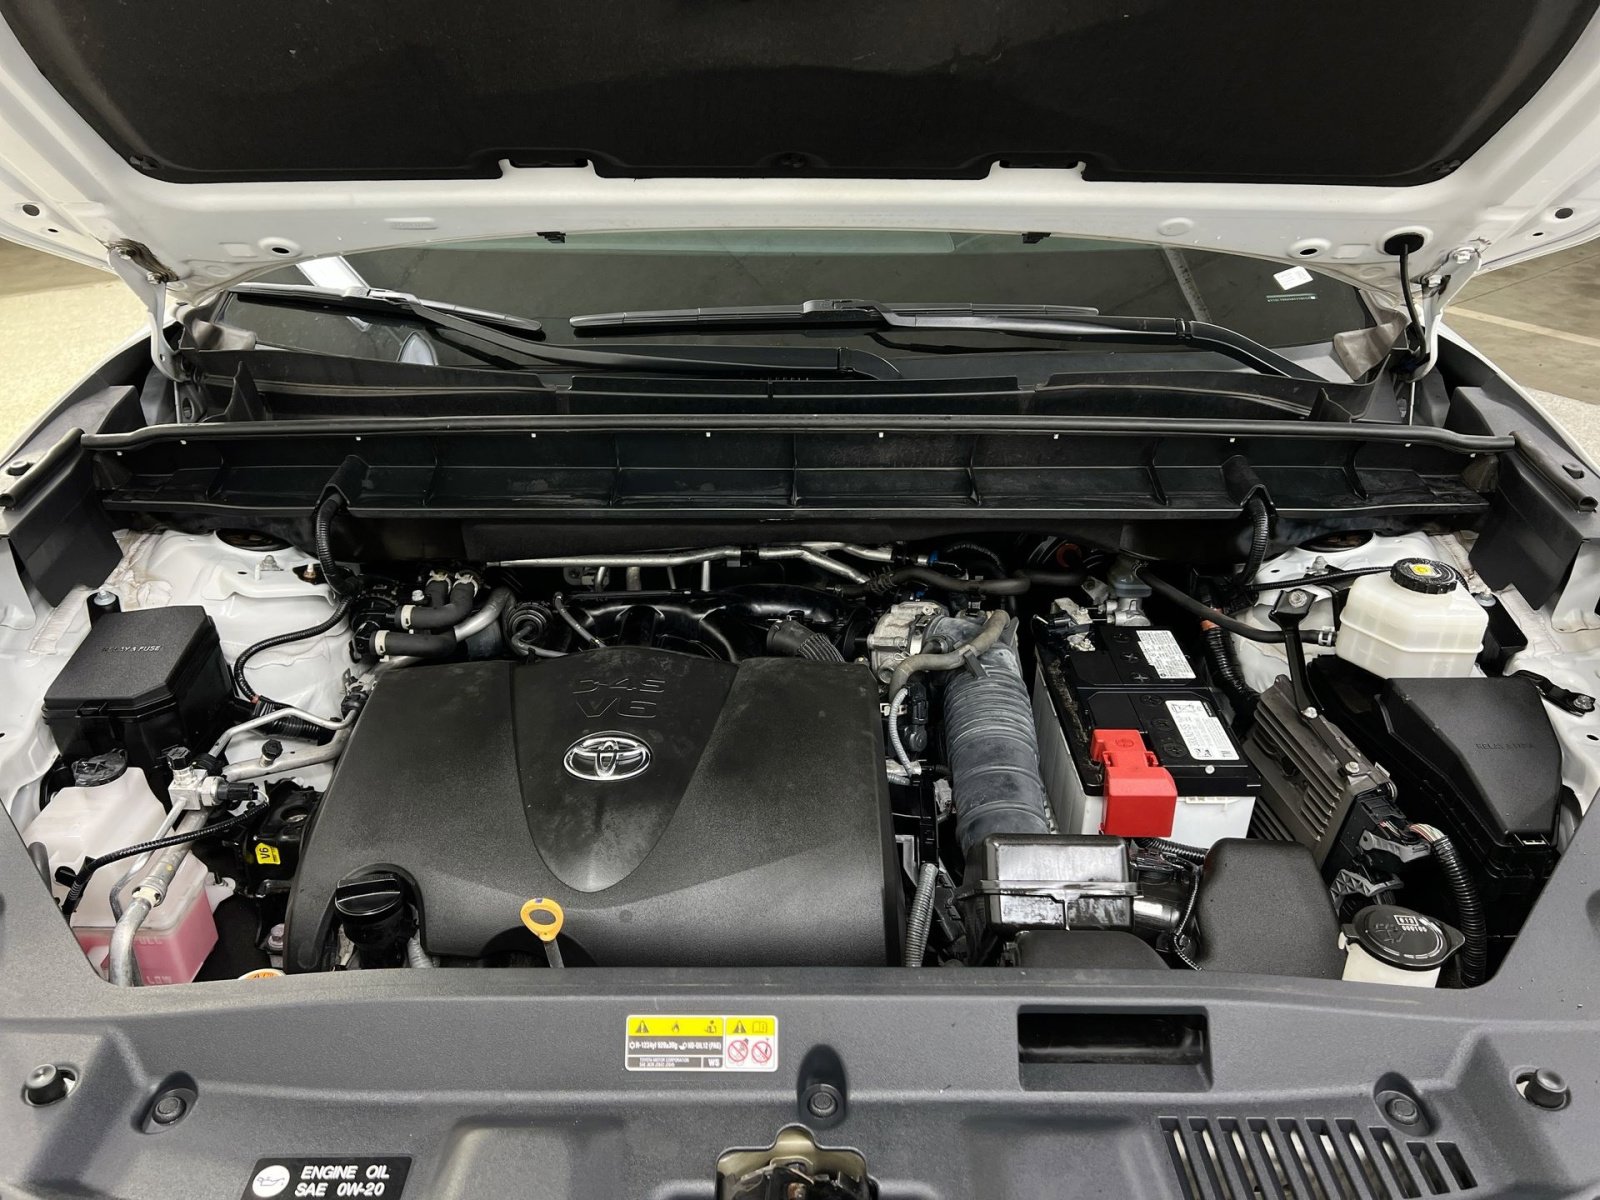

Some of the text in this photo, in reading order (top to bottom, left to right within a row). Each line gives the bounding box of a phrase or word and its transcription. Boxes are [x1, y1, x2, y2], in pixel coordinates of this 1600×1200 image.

[576, 697, 657, 719] V6
[259, 847, 271, 859] V6
[146, 975, 172, 985] LOW
[301, 1165, 390, 1180] ENGINE OIL
[294, 1182, 386, 1197] SAE 0W-20
